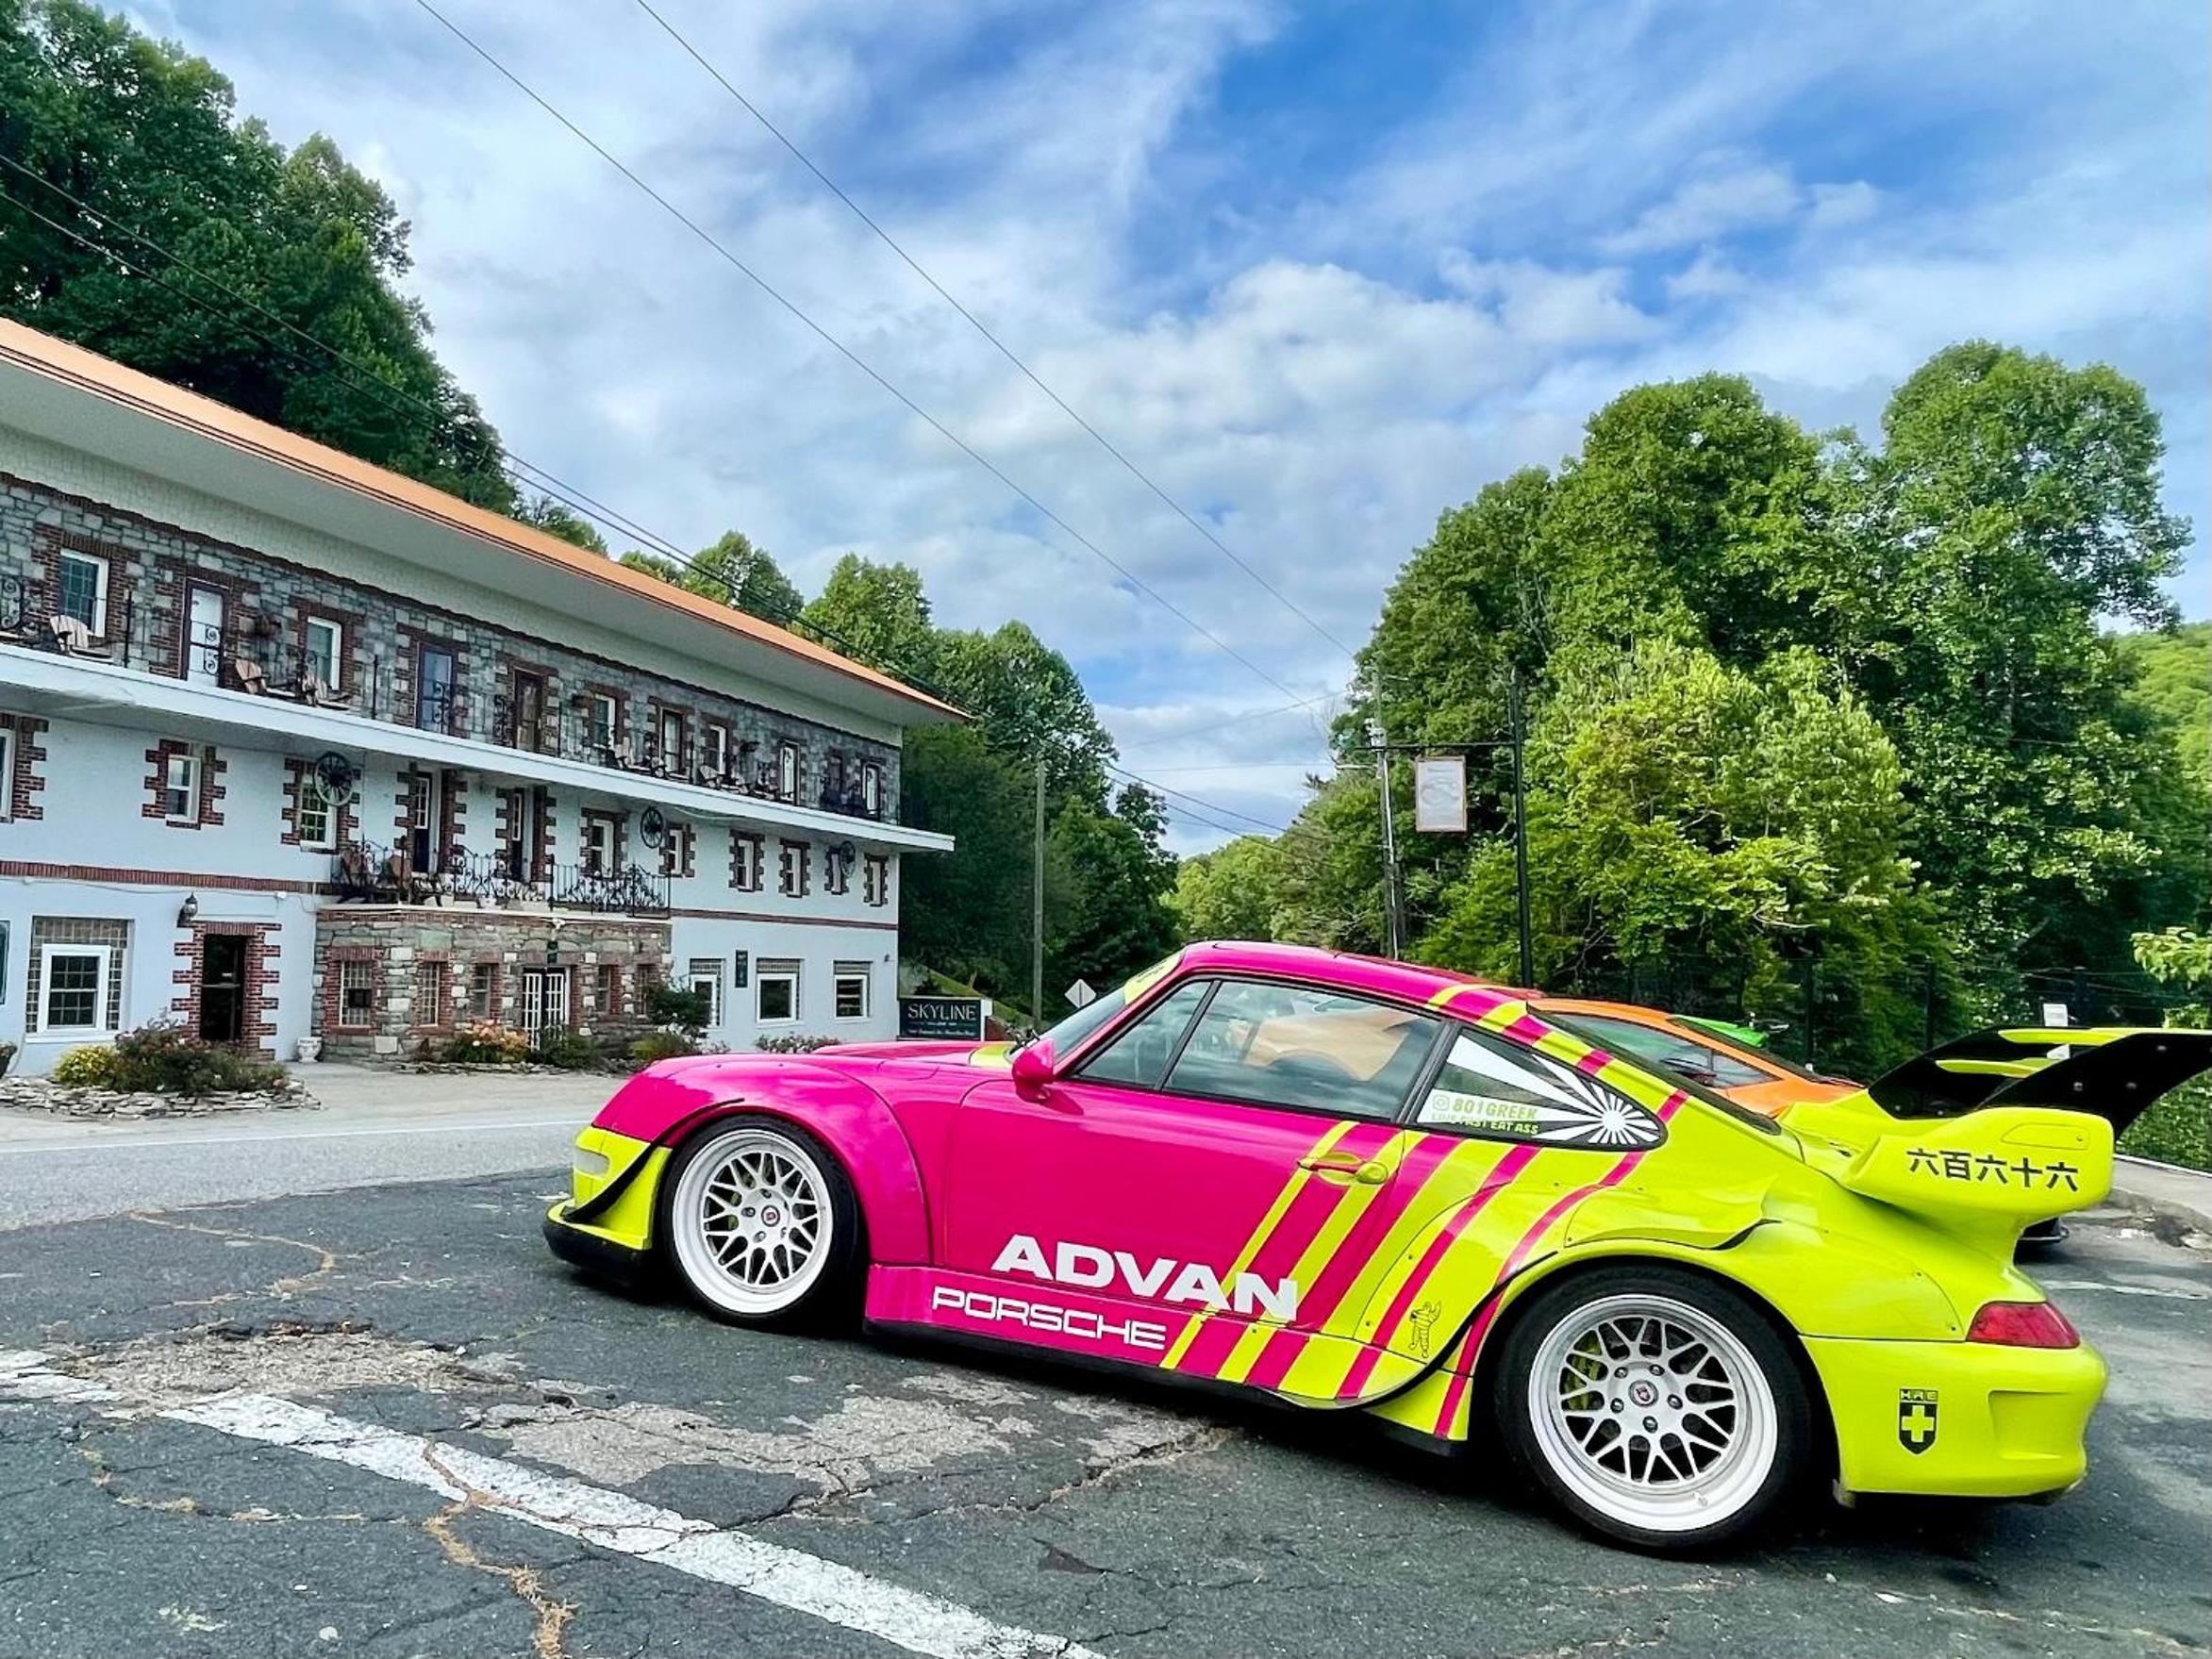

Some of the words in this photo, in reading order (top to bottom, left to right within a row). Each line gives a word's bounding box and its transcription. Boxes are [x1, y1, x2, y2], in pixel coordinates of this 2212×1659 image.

[907, 1004, 976, 1020] SKYLINE
[1514, 1122, 1539, 1136] ASS
[1906, 1148, 2079, 1193] 六百六十六
[991, 1234, 1298, 1321] ADVAN
[932, 1286, 1167, 1351] PORSCHE
